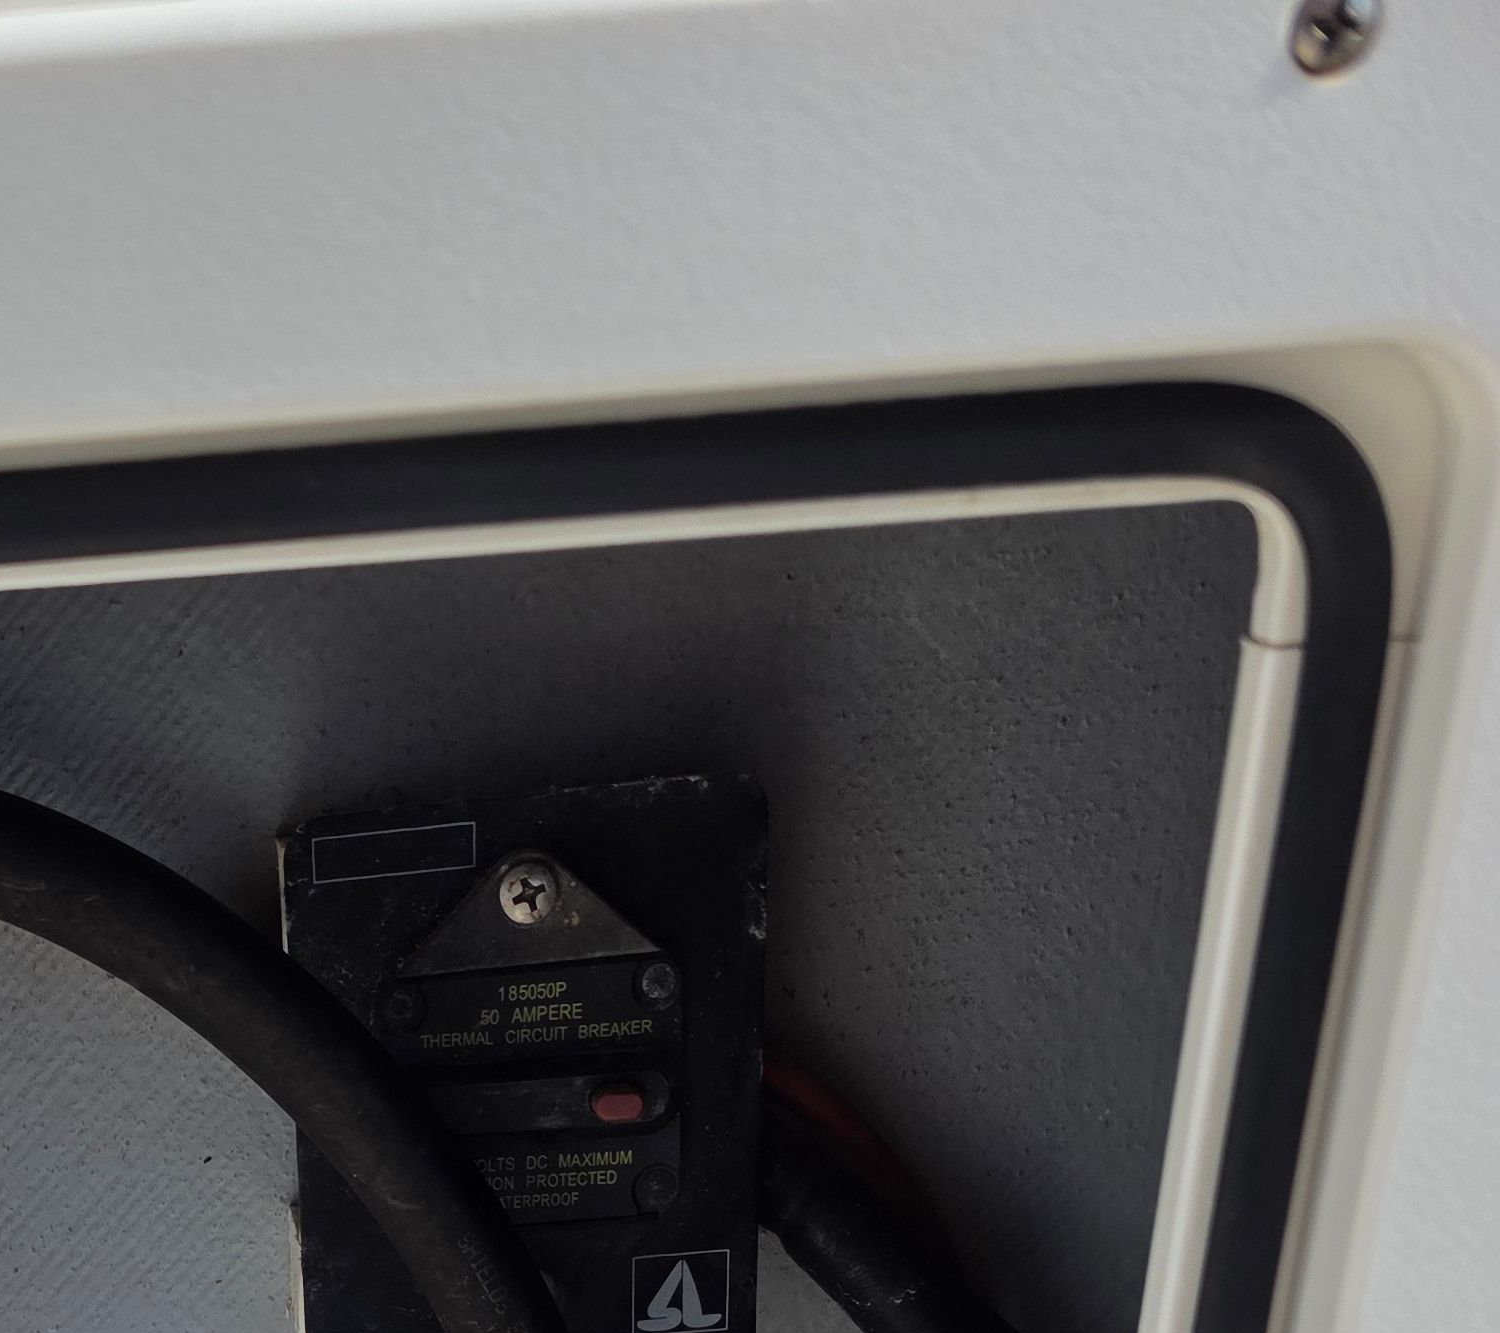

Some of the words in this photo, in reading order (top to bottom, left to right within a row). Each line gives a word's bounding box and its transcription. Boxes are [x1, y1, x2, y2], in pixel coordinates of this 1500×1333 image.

[498, 982, 567, 1002] 185050P
[480, 1009, 499, 1025] 50
[511, 1003, 583, 1024] AMPERE
[421, 1031, 494, 1048] THERMAL
[505, 1026, 568, 1044] CIRCUIT
[579, 1019, 652, 1039] BREAKER
[474, 1157, 515, 1172] OLTS
[526, 1155, 548, 1170] DC
[559, 1150, 632, 1167] MAXIMUM
[526, 1170, 617, 1188] PROTECTED
[500, 1192, 579, 1208] TERPROOF
